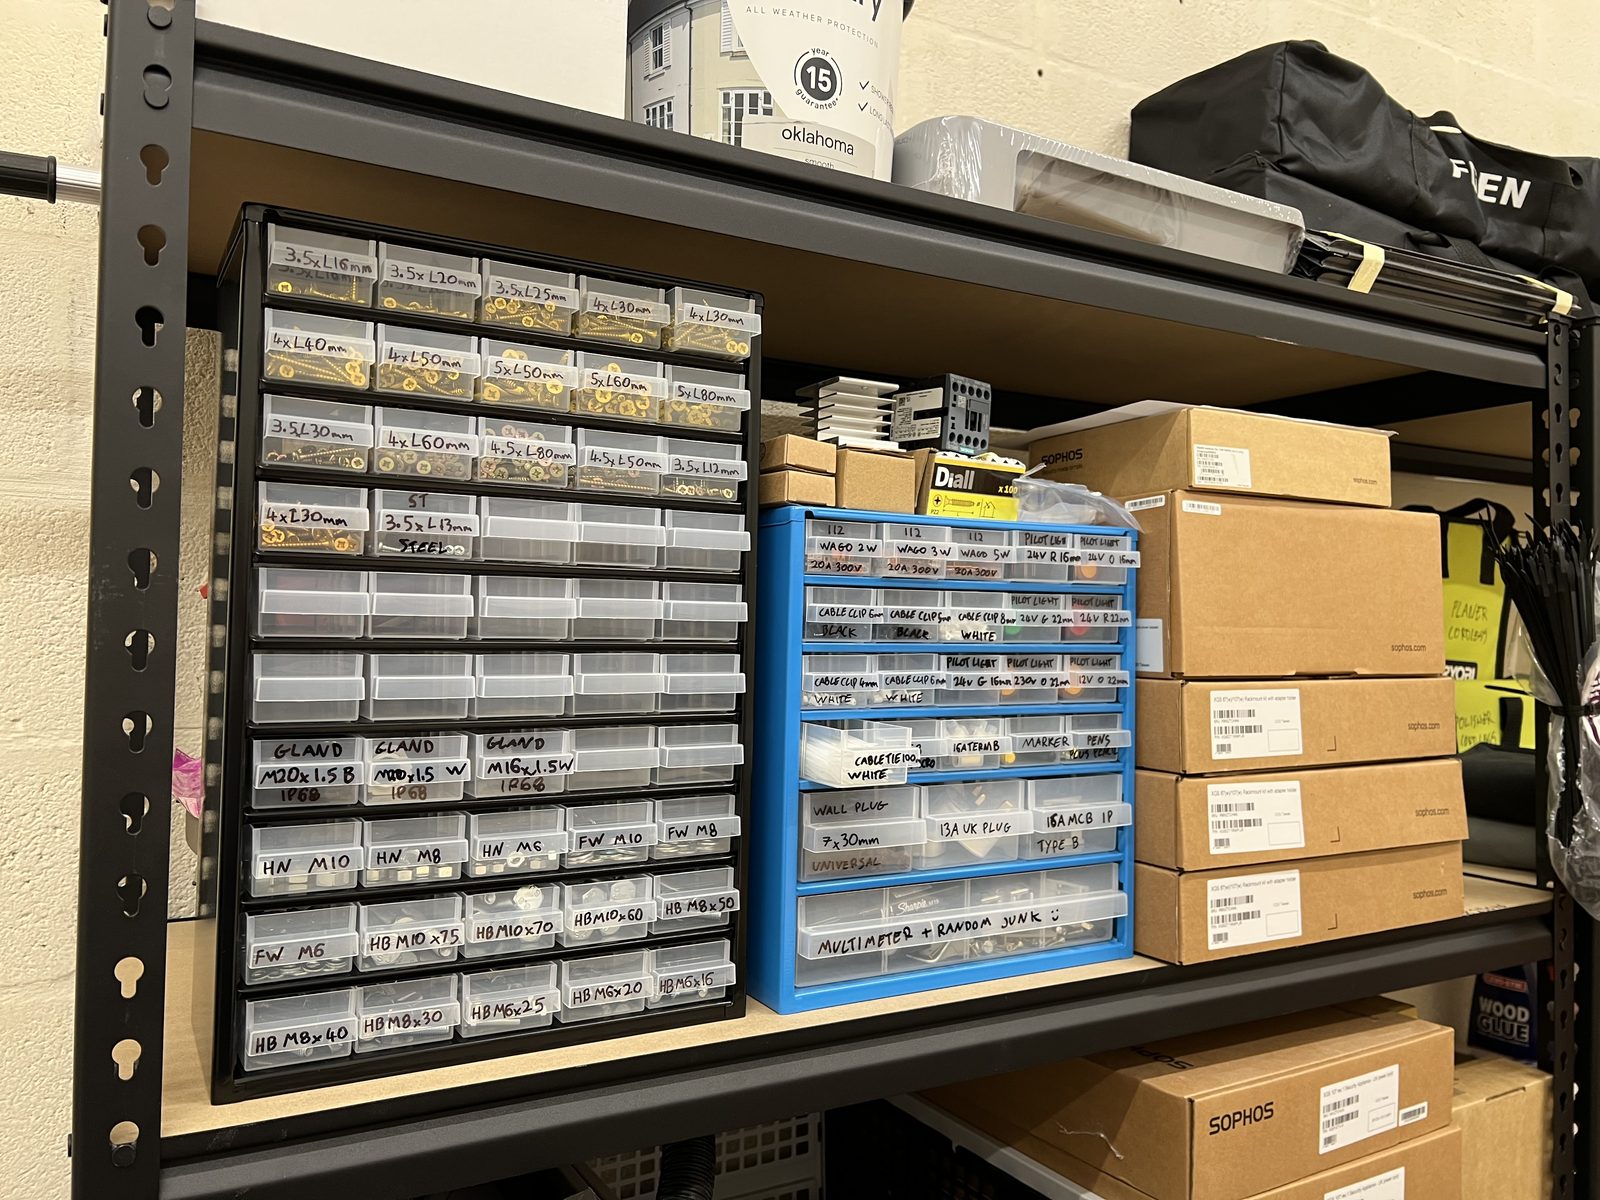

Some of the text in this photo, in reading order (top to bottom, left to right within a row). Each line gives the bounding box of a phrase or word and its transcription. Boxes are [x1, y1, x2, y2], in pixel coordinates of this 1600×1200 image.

[745, 5, 880, 49] ALL WEATHER PROTECTION
[810, 47, 831, 57] year
[805, 64, 833, 94] 15
[781, 125, 855, 156] oklahoma
[494, 280, 568, 303] 3.5xL25mm
[592, 297, 652, 315] 4xL30mm
[688, 306, 745, 327] 4xL30mm
[272, 332, 348, 354] 4xL40mm
[387, 346, 462, 369] 4xL50mm
[493, 360, 564, 381] 5xL50mm
[590, 372, 648, 392] 5xL60mm
[677, 385, 736, 403] 5xL80mm
[1041, 447, 1083, 466] SOPHOS
[934, 465, 976, 490] Diall
[408, 492, 429, 509] ST
[827, 524, 845, 536] 112
[903, 527, 922, 538] 112
[968, 532, 984, 542] 112
[398, 538, 448, 554] STEEL
[819, 539, 853, 552] WAGO
[896, 544, 927, 555] WAGO
[960, 548, 988, 559] WAGO
[1026, 550, 1058, 563] 24V R
[810, 560, 832, 571] 20A
[887, 563, 908, 573] 20A
[818, 607, 867, 619] CABLE CLIP
[890, 609, 937, 622] CABLE CLIP
[821, 624, 857, 639] BLACK
[961, 629, 996, 642] WHITE
[1391, 642, 1426, 654] sophos.com
[946, 656, 970, 669] PILOT
[1006, 656, 1054, 669] PILOT LIGHT
[1069, 656, 1113, 667] PILOT LIGHT
[814, 676, 841, 688] CABLE
[884, 675, 910, 686] CABLE
[814, 693, 853, 704] WHITE
[885, 693, 924, 703] WHITE
[1407, 721, 1441, 732] sophos.com
[374, 739, 434, 755] GLAND
[486, 736, 545, 750] GLAND
[1022, 736, 1070, 749] MARKER
[1087, 734, 1111, 746] PENS
[274, 742, 343, 759] GLAND
[854, 753, 902, 767] CABLE TIE
[445, 762, 467, 776] W
[847, 768, 888, 781] WHITE
[391, 785, 427, 800] IP68
[813, 800, 889, 817] WALL PLUG
[1414, 807, 1450, 818] sophos.com
[1067, 811, 1094, 826] MCB
[668, 822, 718, 839] FW M8
[939, 821, 1012, 838] 13A UK PLUG
[578, 833, 643, 849] FW M10
[822, 832, 880, 851] 7x30mm
[1037, 836, 1080, 854] TYPE B
[376, 848, 442, 865] HN M8
[482, 841, 543, 858] HN M6
[263, 854, 351, 876] HN M10
[811, 856, 882, 873] UNIVERSAL
[1412, 887, 1448, 900] sophos.com
[665, 896, 735, 915] HB M8x50
[574, 912, 592, 927] HB
[476, 925, 495, 940] HB
[817, 911, 1043, 955] MULTIMETER + RANDOM JUNK
[369, 935, 391, 952] HB
[254, 943, 325, 965] FW M6
[660, 971, 715, 994] HB M6x16
[573, 981, 643, 1005] HB M6x20
[472, 997, 545, 1020] HB M6x25
[1479, 995, 1531, 1023] WOOD
[364, 1010, 443, 1034] HB M8x30
[1477, 1013, 1530, 1043] GLUE
[255, 1026, 349, 1054] HB M8x40
[1208, 1101, 1275, 1136] SOPHOS
